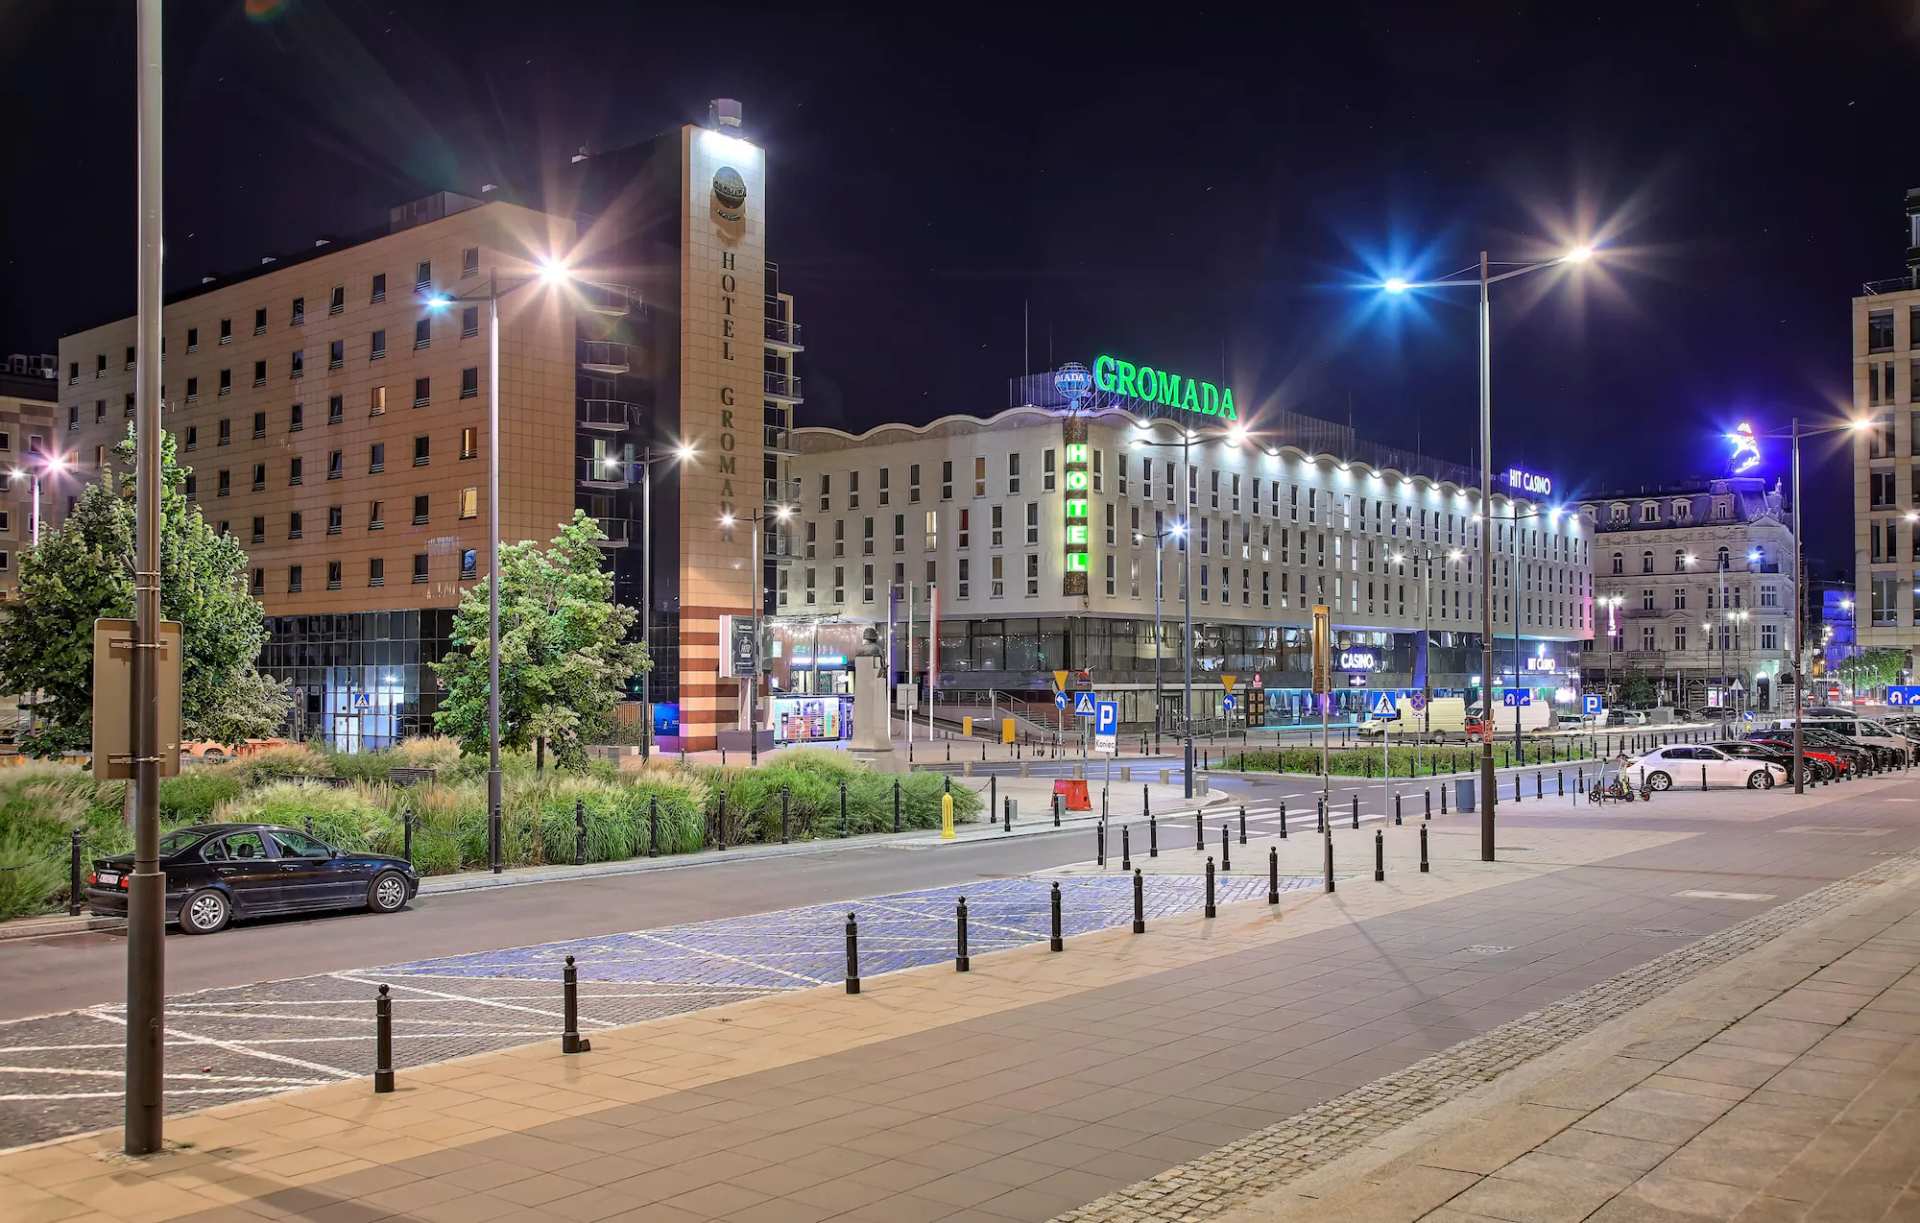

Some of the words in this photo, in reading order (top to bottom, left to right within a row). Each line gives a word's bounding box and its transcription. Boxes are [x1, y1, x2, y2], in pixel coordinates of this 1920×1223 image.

[722, 251, 736, 361] HOTEL
[1095, 355, 1237, 420] GROMADA
[1510, 468, 1522, 489] HIT
[1523, 472, 1551, 495] CASINO
[1067, 444, 1087, 572] HOTEL
[1341, 653, 1374, 669] CASINO
[1587, 696, 1598, 713] P
[1101, 705, 1113, 732] P
